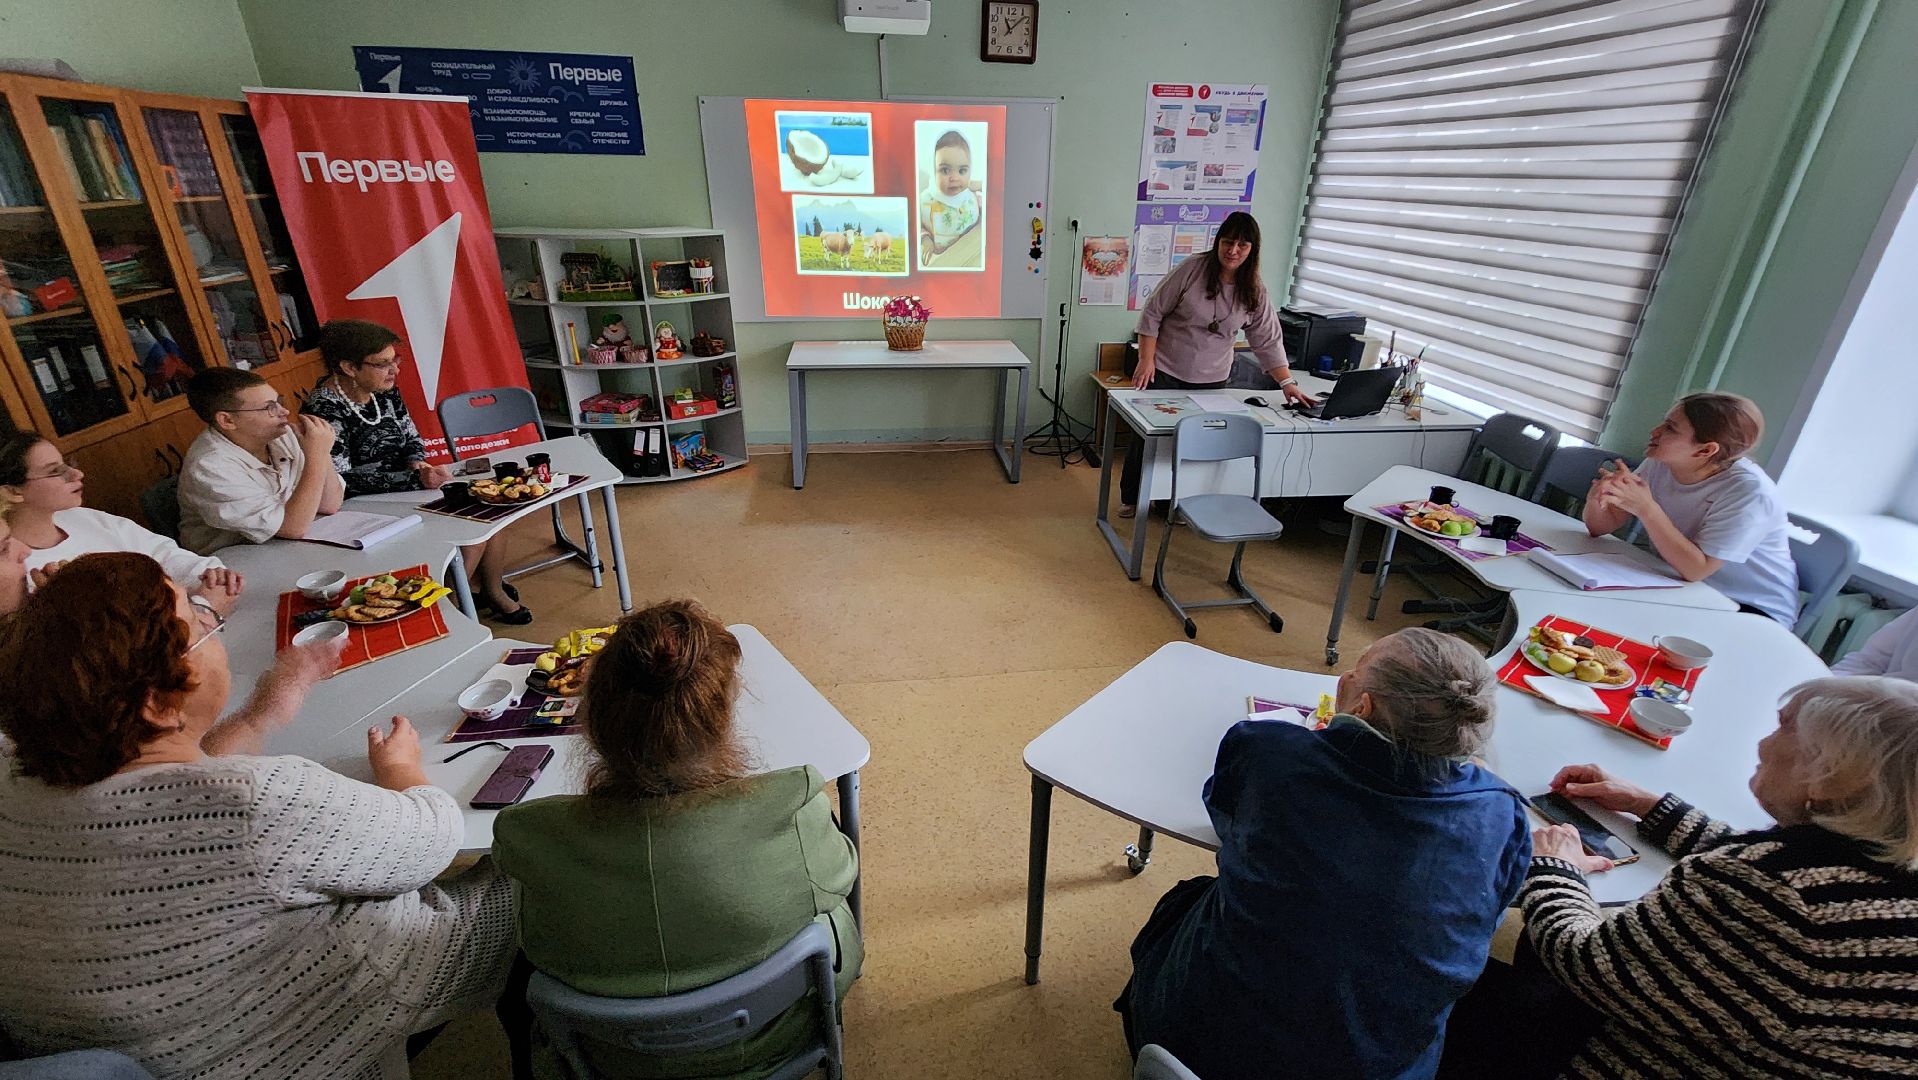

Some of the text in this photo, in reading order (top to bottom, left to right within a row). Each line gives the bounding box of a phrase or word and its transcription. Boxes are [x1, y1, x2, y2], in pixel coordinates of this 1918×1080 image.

[991, 14, 998, 22] 10
[1024, 39, 1029, 47] 4
[369, 52, 401, 62] Первые
[433, 69, 453, 78] ТРУД
[549, 63, 623, 86] Первые
[493, 96, 560, 104] СПРАВЕДЛИВОСТЬ
[483, 108, 547, 116] ВЗАИМОПОМОЩЬ
[506, 131, 562, 139] ИСТОРИЧЕСКАЯ
[296, 151, 456, 193] Первые
